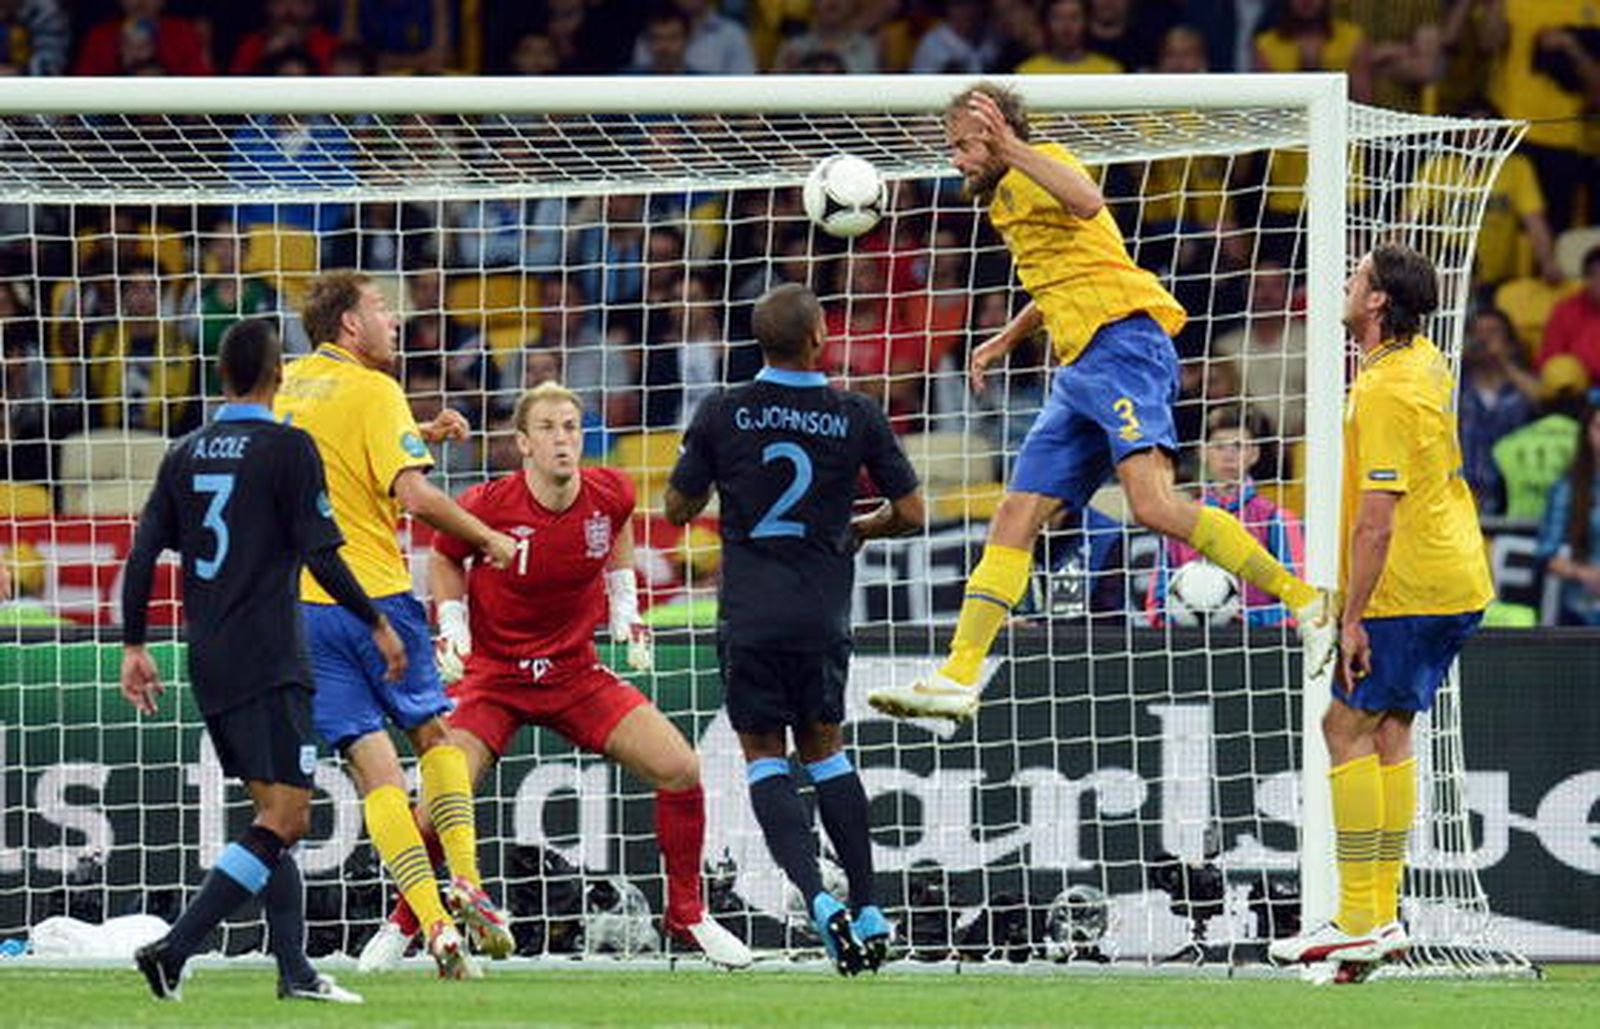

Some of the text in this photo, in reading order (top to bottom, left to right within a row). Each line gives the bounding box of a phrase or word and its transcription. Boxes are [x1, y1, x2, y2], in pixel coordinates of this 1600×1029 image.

[735, 407, 848, 438] G.JOHNSON
[1112, 397, 1139, 433] 3
[193, 436, 250, 459] A.COLE
[750, 442, 812, 538] 2
[193, 473, 235, 580] 3
[516, 538, 530, 575] 1
